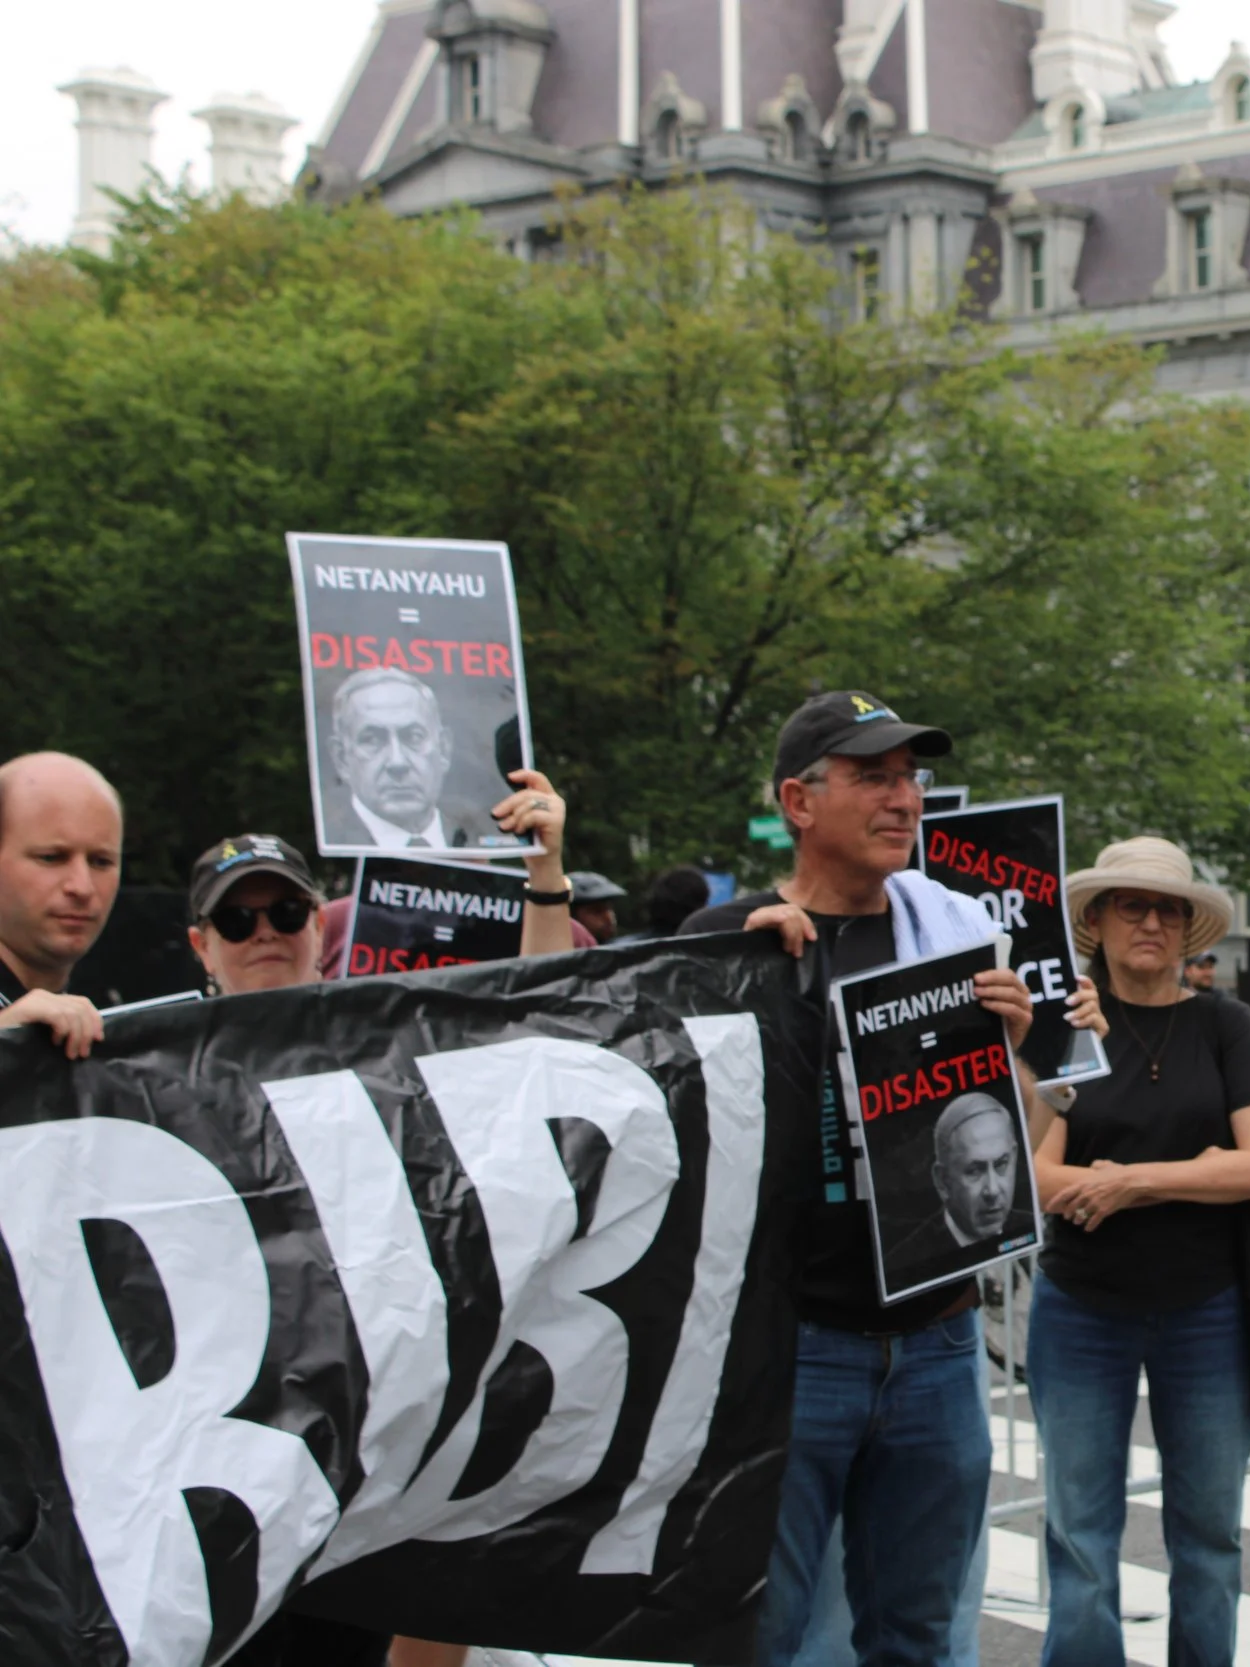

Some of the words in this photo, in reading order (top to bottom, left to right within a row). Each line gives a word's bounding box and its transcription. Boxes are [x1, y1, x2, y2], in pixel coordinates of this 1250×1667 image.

[315, 564, 487, 598] NETANYAHU
[311, 632, 514, 678] DISASTER
[927, 829, 1058, 907] DISASTER
[369, 879, 521, 923] NETANYAHU
[976, 888, 1029, 931] OR
[859, 1044, 1012, 1121] DISASTER
[0, 1012, 766, 1667] BIBI
